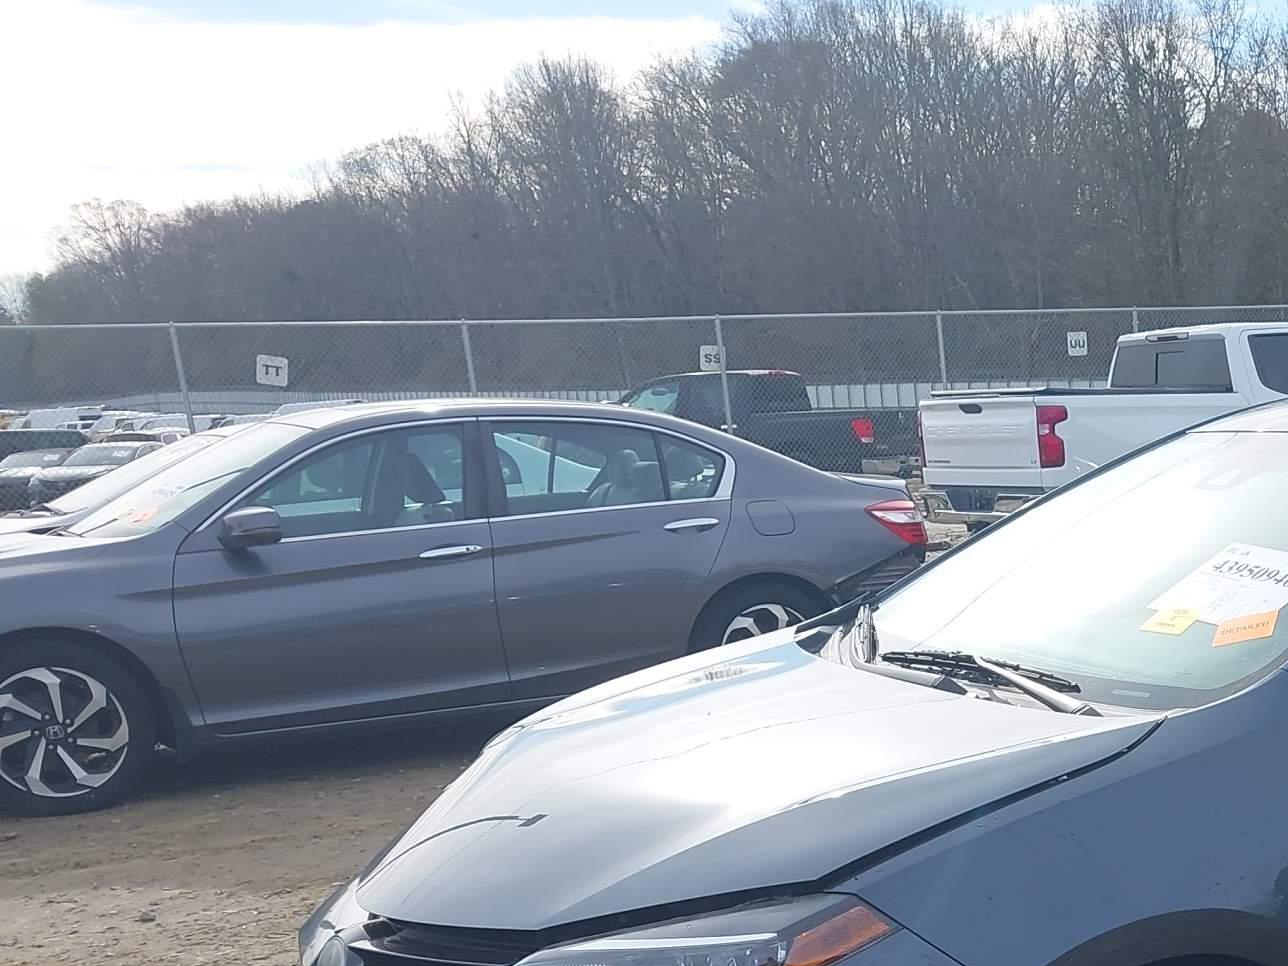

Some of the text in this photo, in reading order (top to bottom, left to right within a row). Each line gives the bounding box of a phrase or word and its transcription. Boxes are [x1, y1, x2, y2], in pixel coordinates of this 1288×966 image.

[1070, 339, 1085, 349] UU
[704, 353, 721, 364] SS
[262, 364, 282, 376] TT
[1220, 621, 1271, 636] DETAILED
